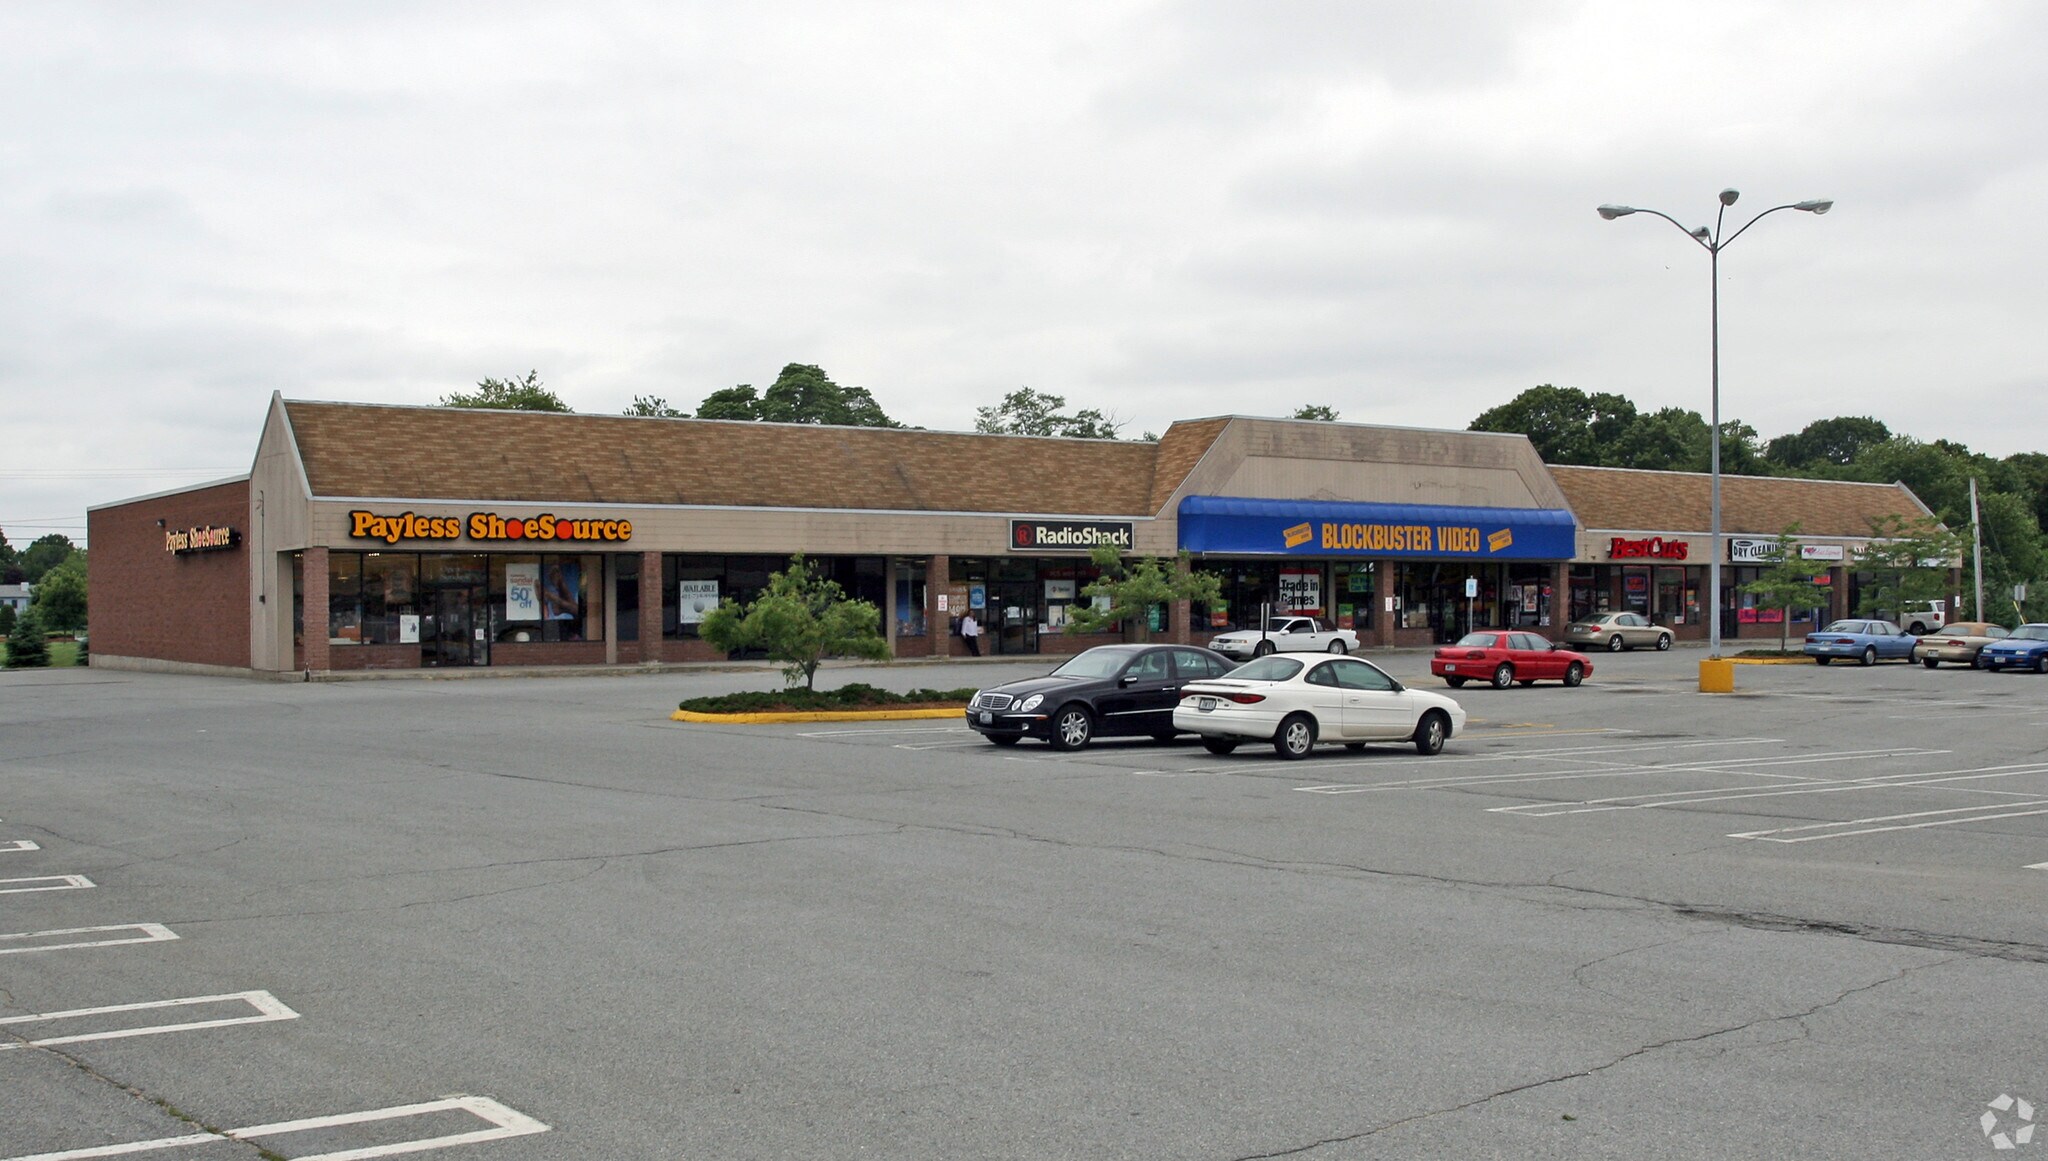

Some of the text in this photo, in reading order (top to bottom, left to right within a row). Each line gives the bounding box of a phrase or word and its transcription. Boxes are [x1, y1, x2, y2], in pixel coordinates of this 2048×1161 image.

[352, 511, 632, 543] Payless ShoeSource
[166, 525, 230, 555] Payless ShoeSource
[1036, 526, 1130, 546] RadioShack
[1322, 523, 1480, 552] BLOCKBUSTER VIDEO
[1734, 544, 1784, 557] DRY CLEANIN
[683, 585, 716, 593] AVAILABLE
[1281, 580, 1318, 591] Trade in
[1281, 594, 1315, 605] Games
